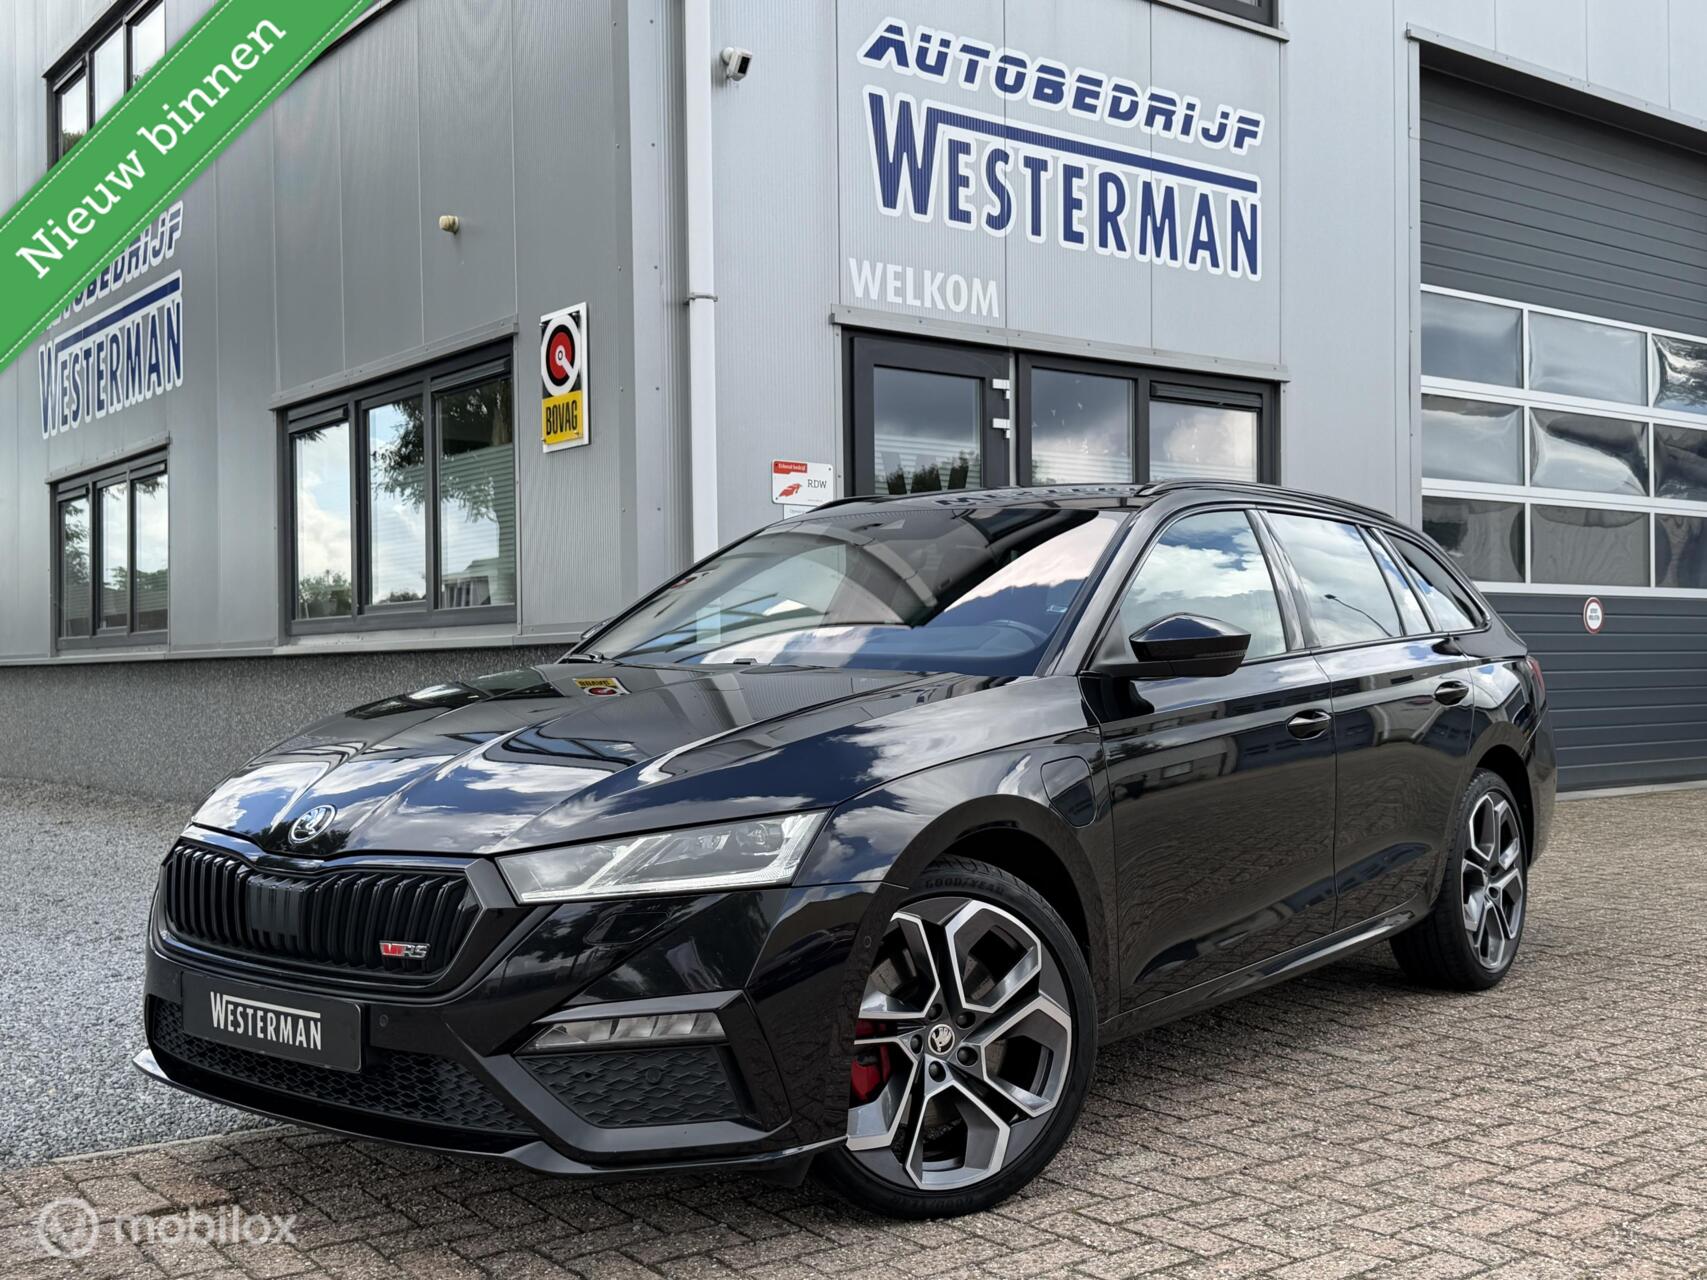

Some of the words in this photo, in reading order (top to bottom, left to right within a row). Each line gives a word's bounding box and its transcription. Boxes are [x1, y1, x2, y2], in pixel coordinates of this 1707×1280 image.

[865, 89, 1260, 279] WESTERMAN
[849, 257, 999, 318] WELKOM
[39, 283, 182, 438] WESTERMAN
[545, 400, 578, 436] BOVAG
[807, 479, 827, 489] RDW
[210, 991, 321, 1050] WESTERMAN
